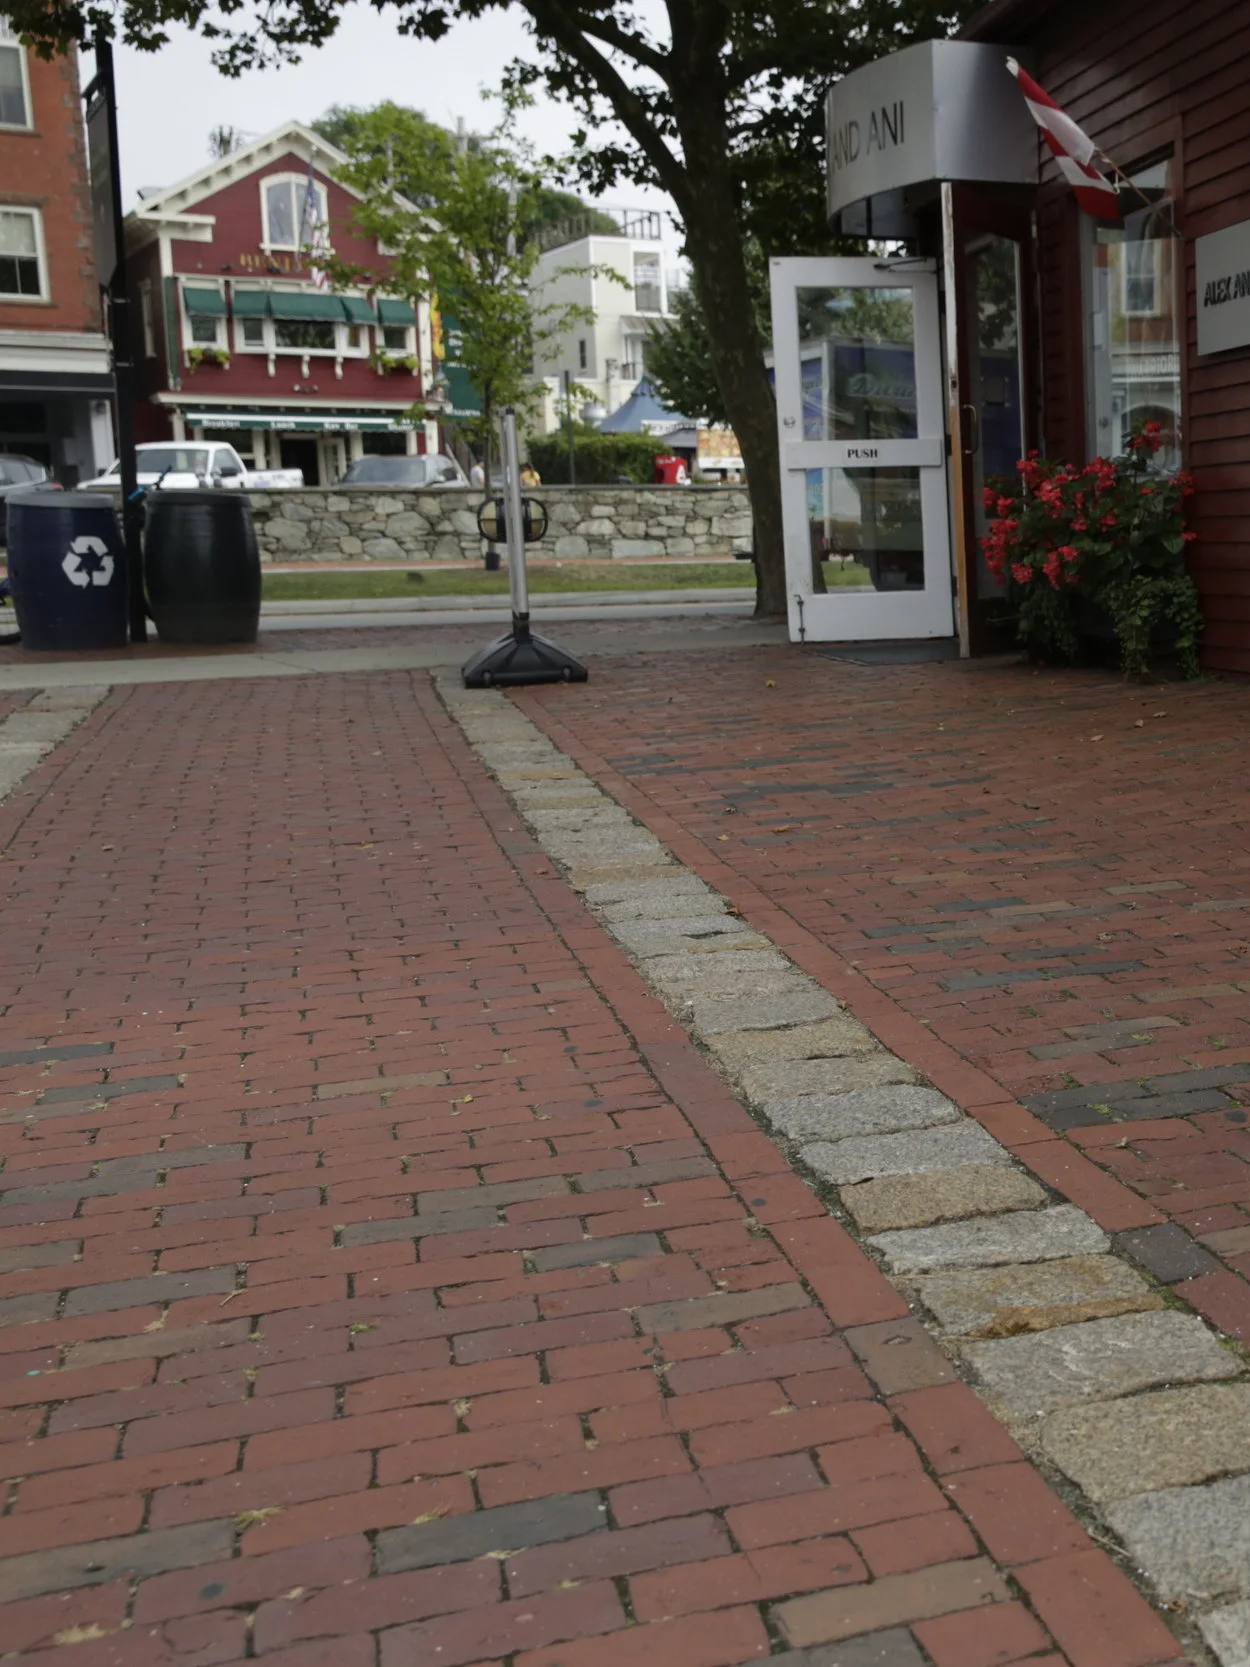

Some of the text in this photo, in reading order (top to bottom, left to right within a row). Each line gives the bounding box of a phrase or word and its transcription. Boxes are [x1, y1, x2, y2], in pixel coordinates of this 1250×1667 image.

[832, 120, 860, 174] AND
[866, 100, 905, 156] ANI
[1203, 275, 1232, 308] ALEX
[847, 448, 879, 459] PUSH
